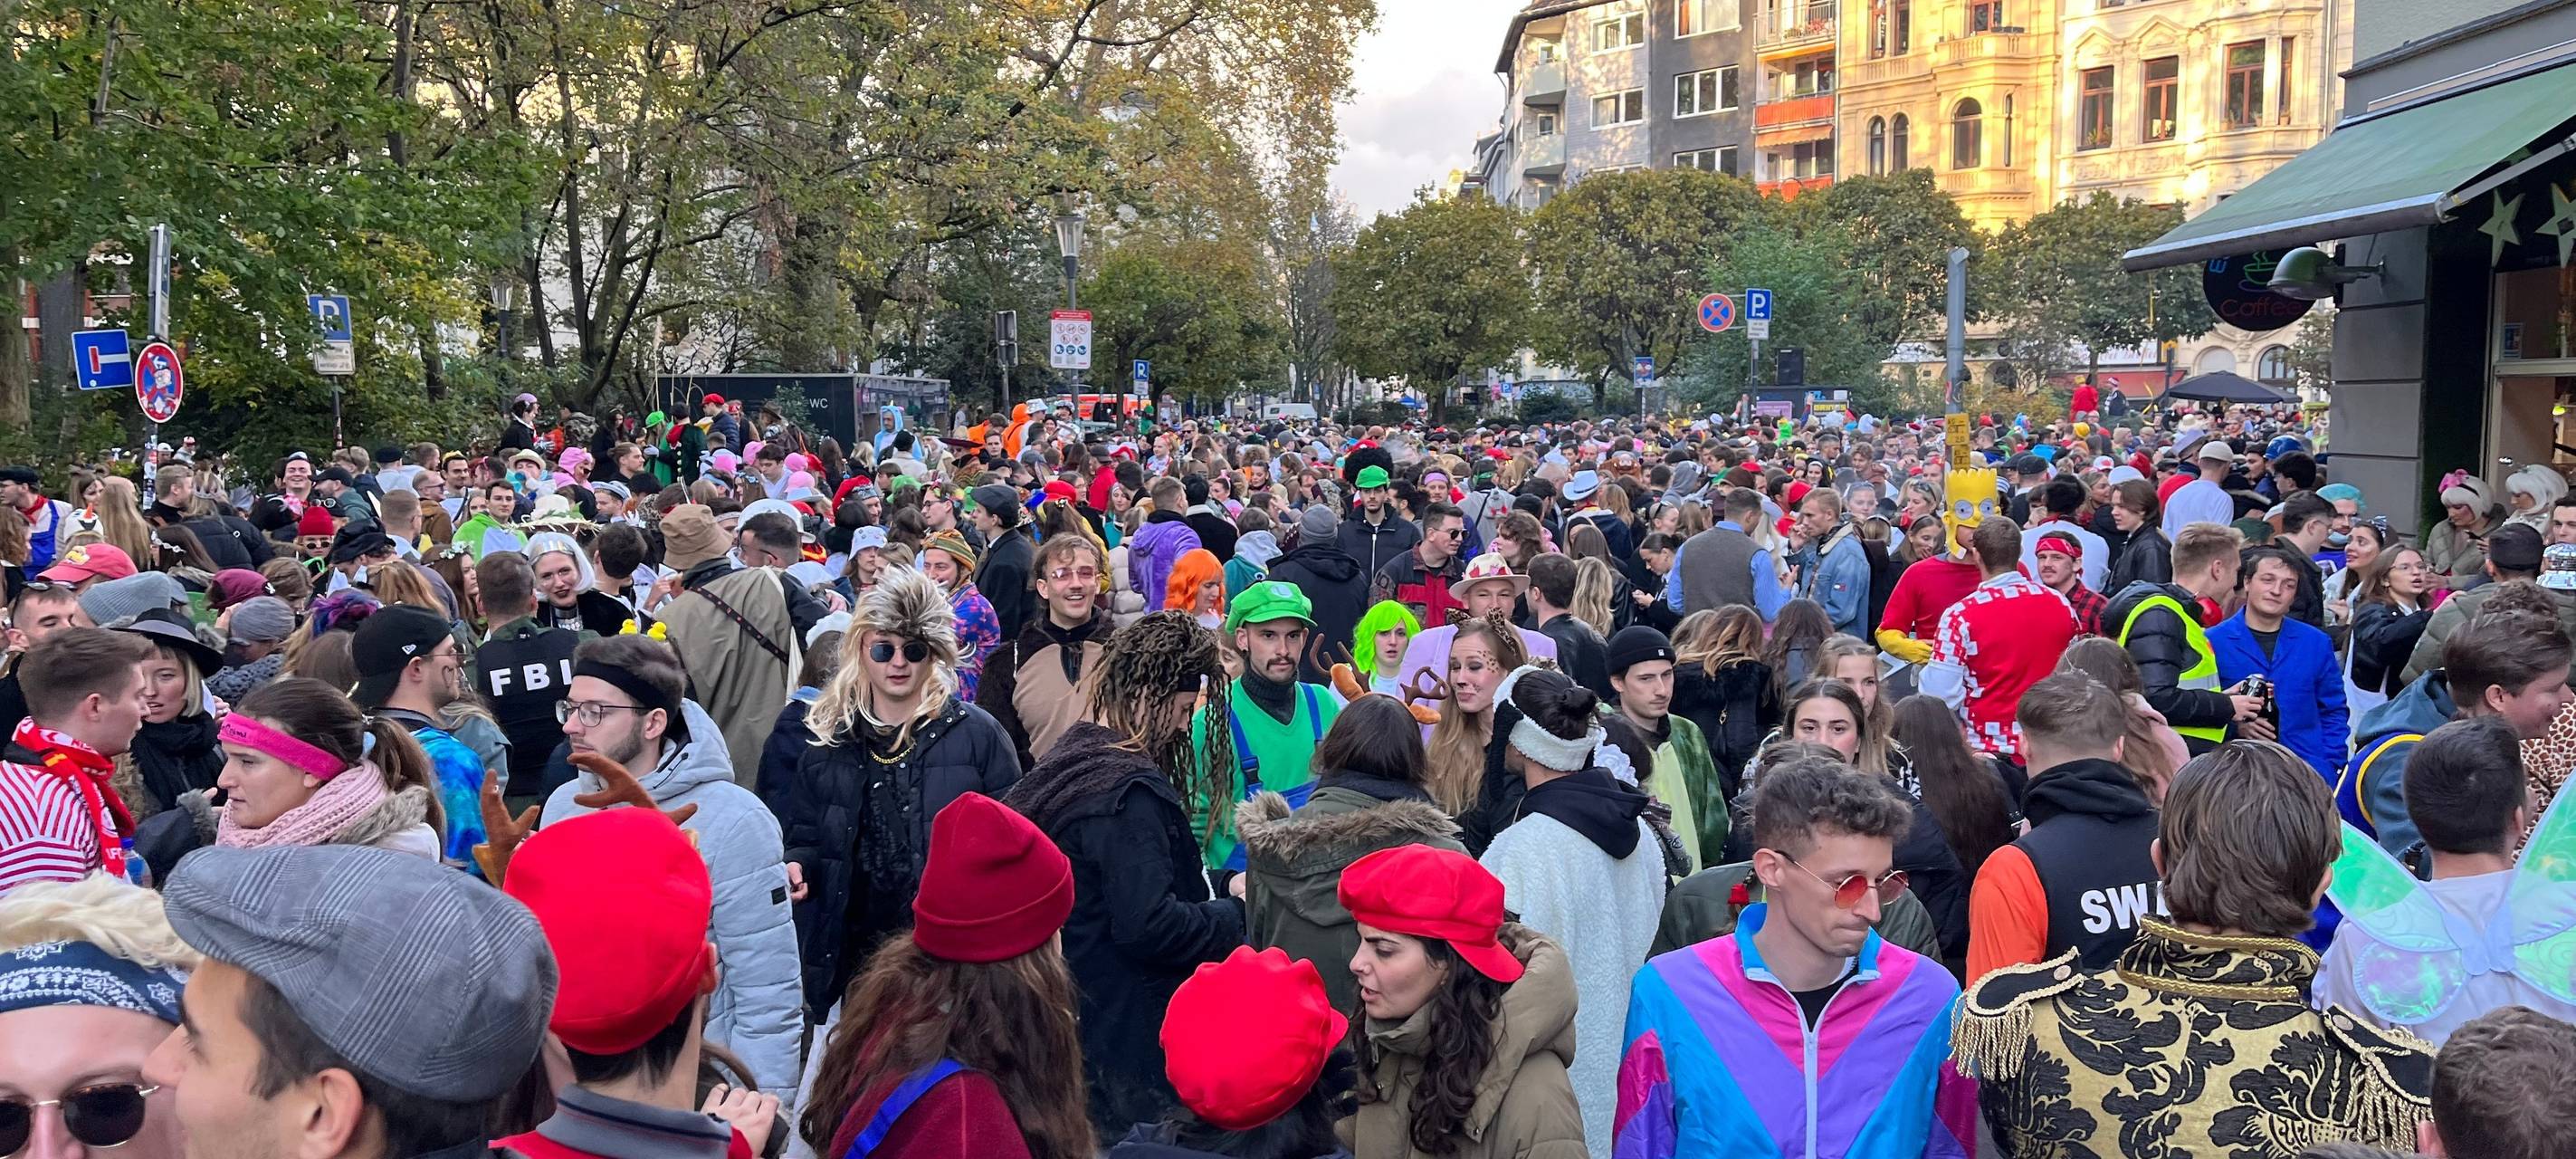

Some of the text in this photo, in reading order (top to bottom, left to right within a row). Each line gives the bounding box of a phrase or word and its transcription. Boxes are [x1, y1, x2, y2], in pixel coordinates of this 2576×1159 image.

[1751, 293, 1766, 317] P
[2220, 297, 2303, 317] Coffee
[809, 398, 828, 408] WC
[490, 659, 572, 696] FBI
